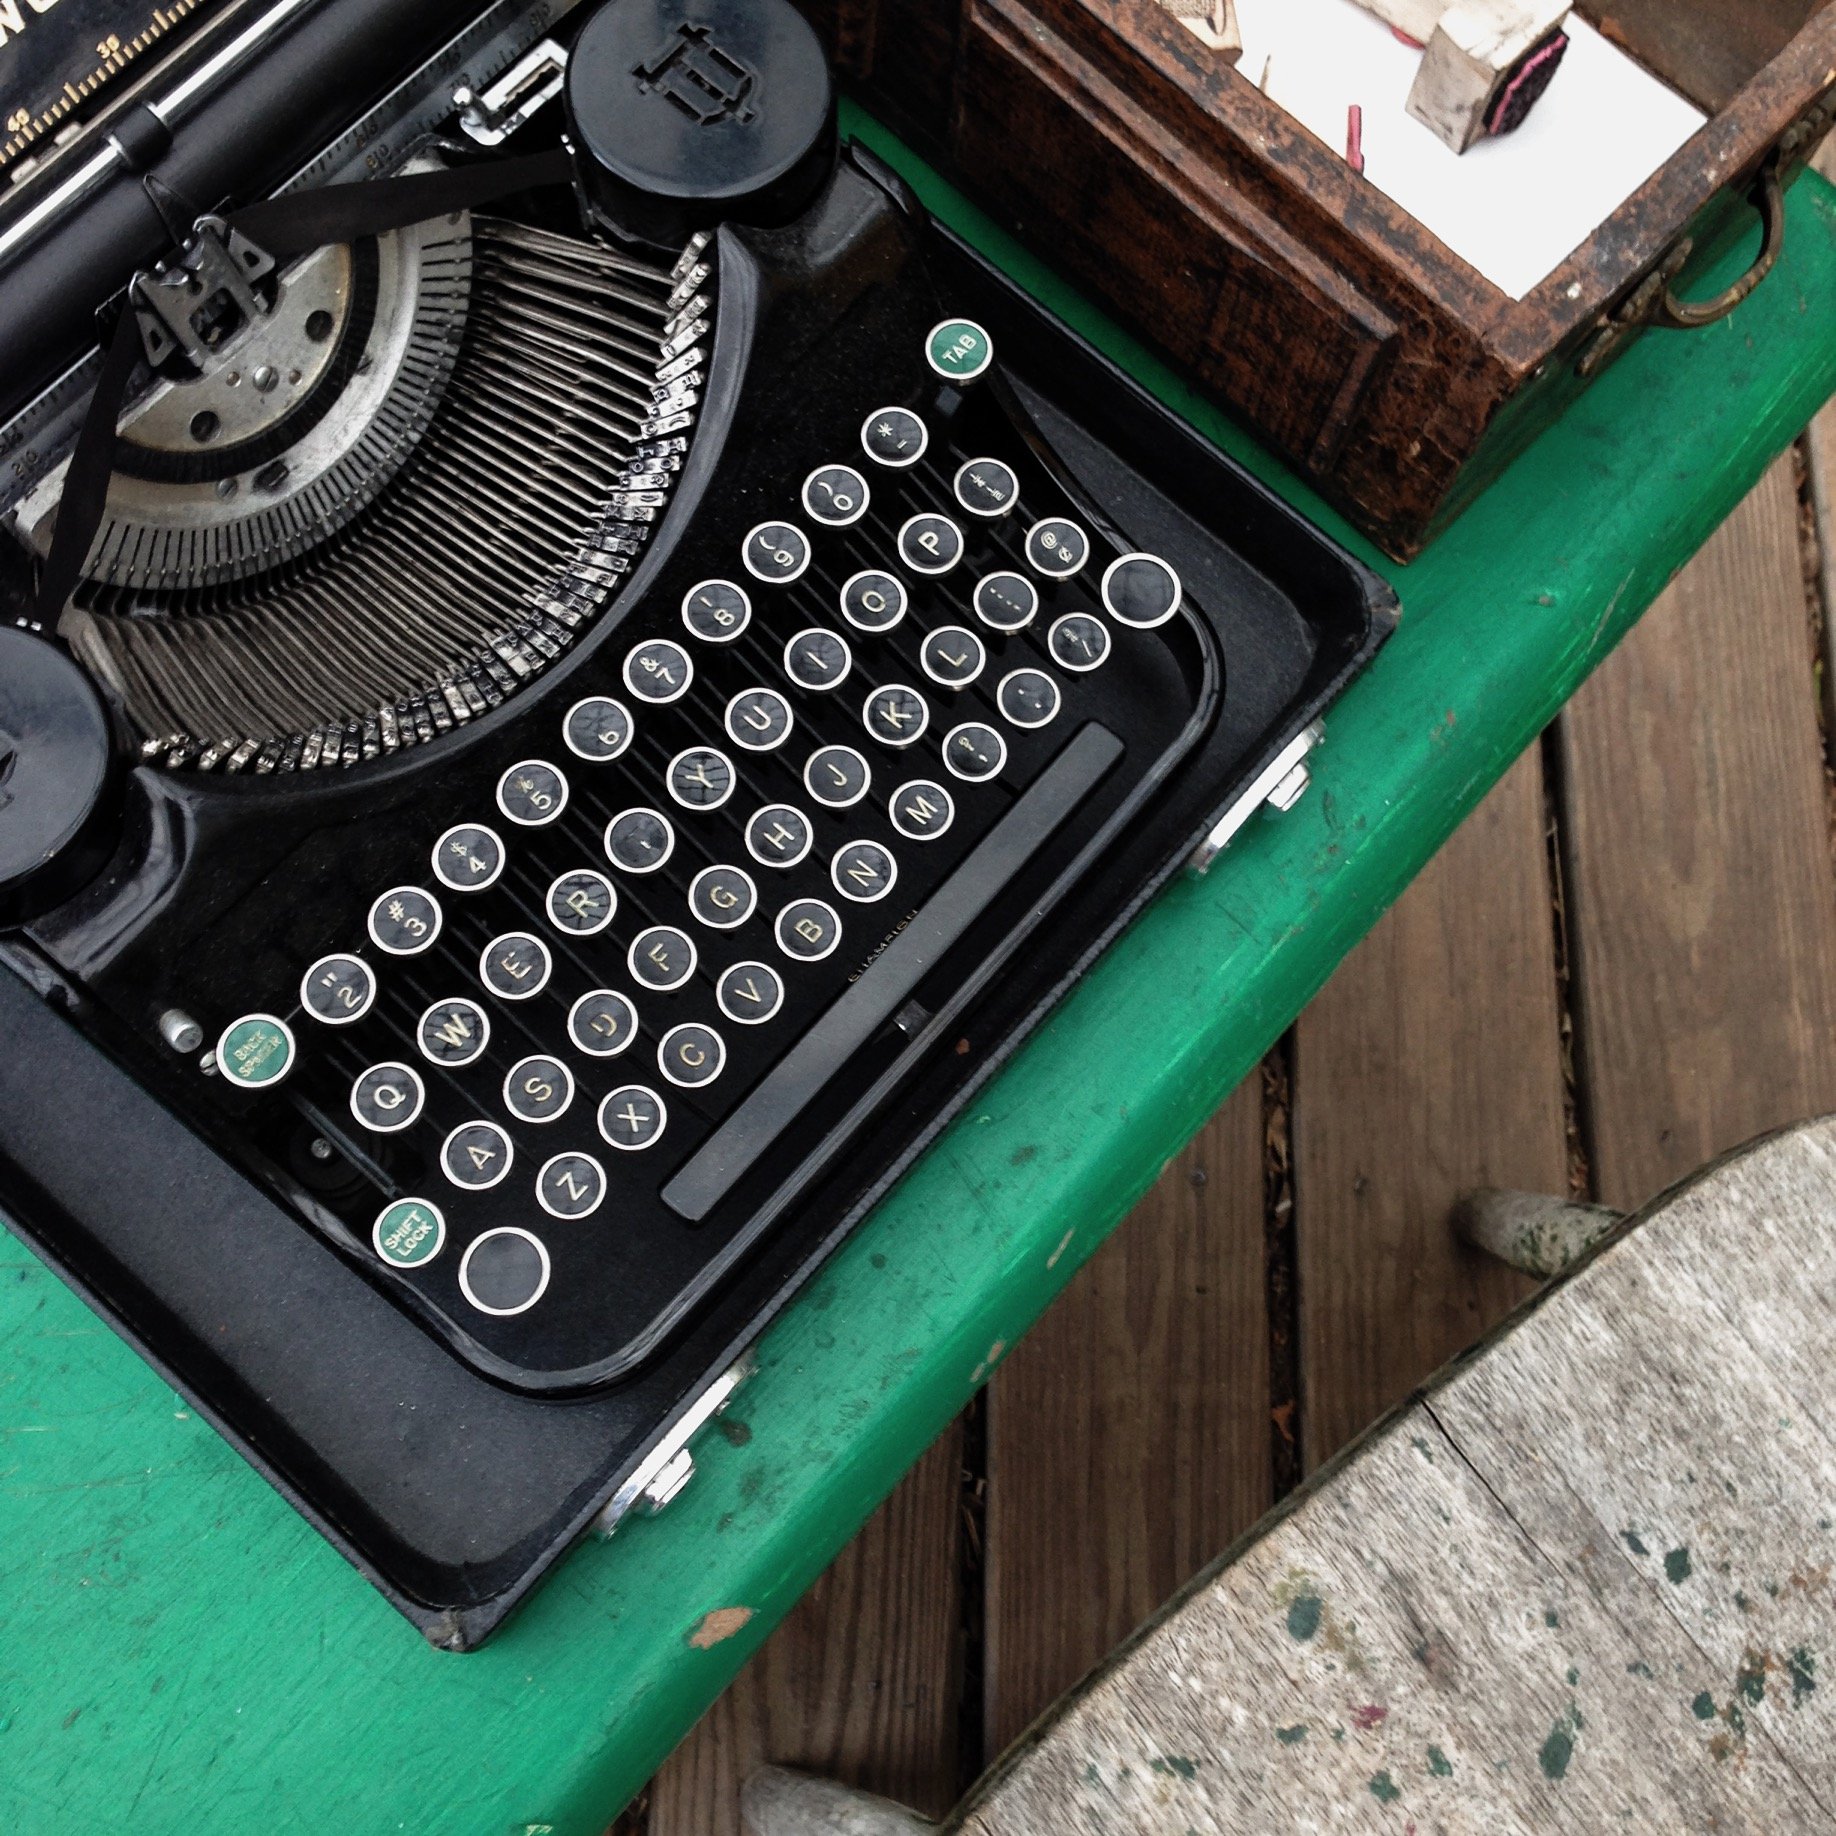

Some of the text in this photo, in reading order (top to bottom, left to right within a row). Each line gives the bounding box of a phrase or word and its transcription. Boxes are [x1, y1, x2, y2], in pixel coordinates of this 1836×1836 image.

[96, 33, 120, 59] 30
[7, 107, 30, 132] 40
[942, 333, 977, 365] TAB
[11, 450, 38, 476] 20
[917, 530, 940, 557] P
[1040, 530, 1059, 550] @
[773, 549, 795, 567] 9
[861, 589, 887, 613] O
[713, 608, 735, 626] 8
[806, 651, 829, 670] I
[937, 648, 969, 667] L
[655, 667, 676, 684] 7
[743, 705, 772, 731] U
[879, 700, 913, 729] K
[597, 730, 620, 745] 6
[684, 763, 714, 789] Y
[826, 762, 848, 787] J
[529, 790, 551, 810] 5
[904, 794, 939, 826] M
[763, 821, 796, 850] H
[468, 855, 487, 874] 4
[846, 858, 879, 888] N
[565, 889, 600, 918] R
[709, 884, 738, 909] G
[387, 899, 406, 922] #
[403, 916, 428, 937] 3
[793, 917, 824, 944] B
[500, 950, 534, 980] E
[647, 941, 671, 972] F
[336, 986, 363, 1009] 2
[733, 977, 762, 1003] V
[433, 1012, 472, 1048] W
[590, 1012, 618, 1038] D
[232, 1029, 267, 1062] BACK
[678, 1042, 706, 1068] C
[373, 1084, 407, 1110] Q
[523, 1076, 553, 1102] S
[616, 1102, 650, 1133] X
[466, 1145, 497, 1171] A
[554, 1170, 589, 1201] Z
[383, 1208, 423, 1250] SHIFT
[395, 1219, 434, 1257] LOCK
